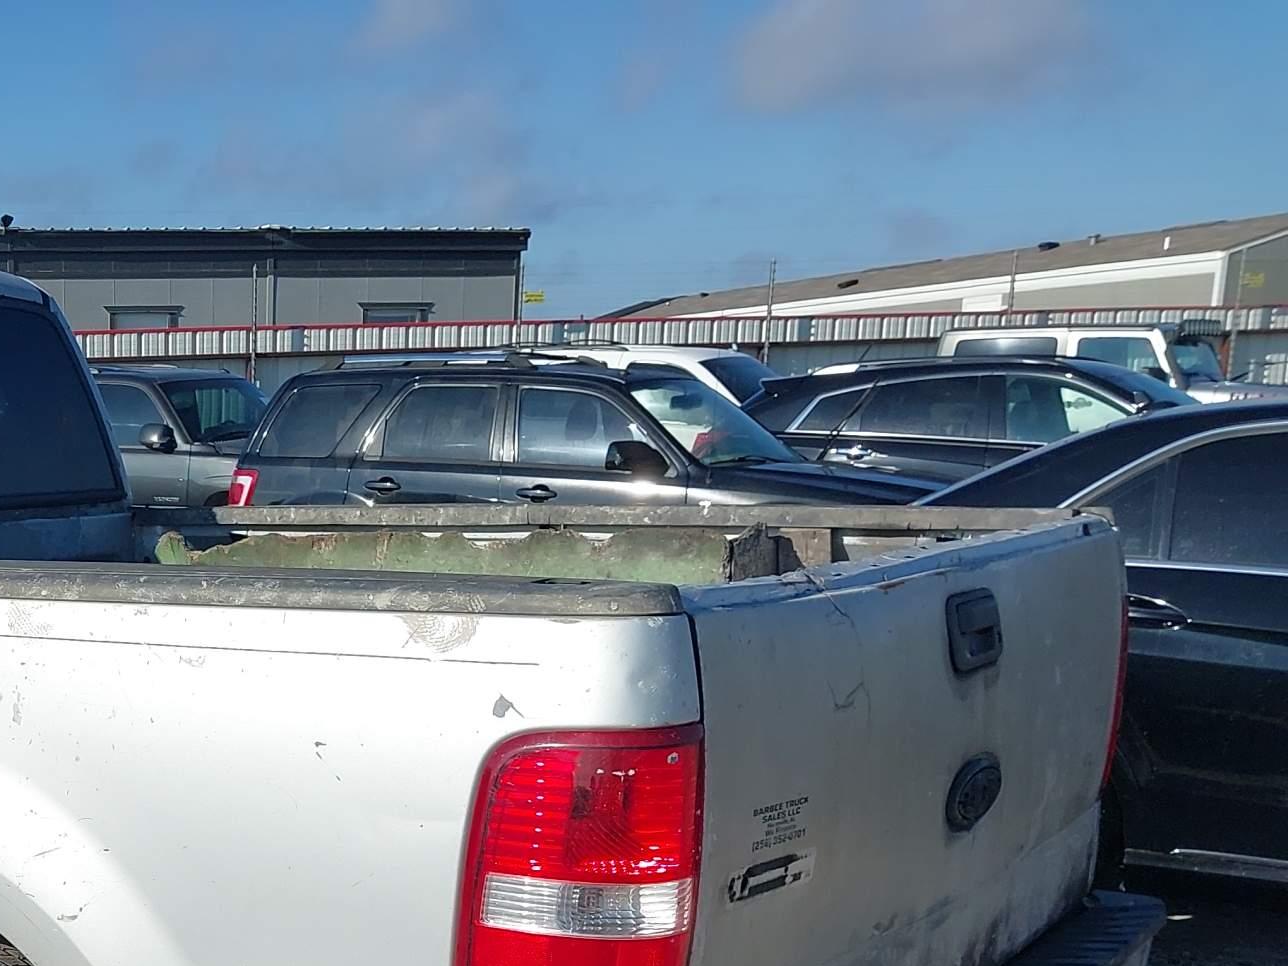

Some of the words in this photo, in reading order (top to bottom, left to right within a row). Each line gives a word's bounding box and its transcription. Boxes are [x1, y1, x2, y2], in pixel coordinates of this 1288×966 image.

[785, 796, 809, 809] TRUCK
[762, 811, 786, 824] SALES
[787, 806, 801, 817] LLC
